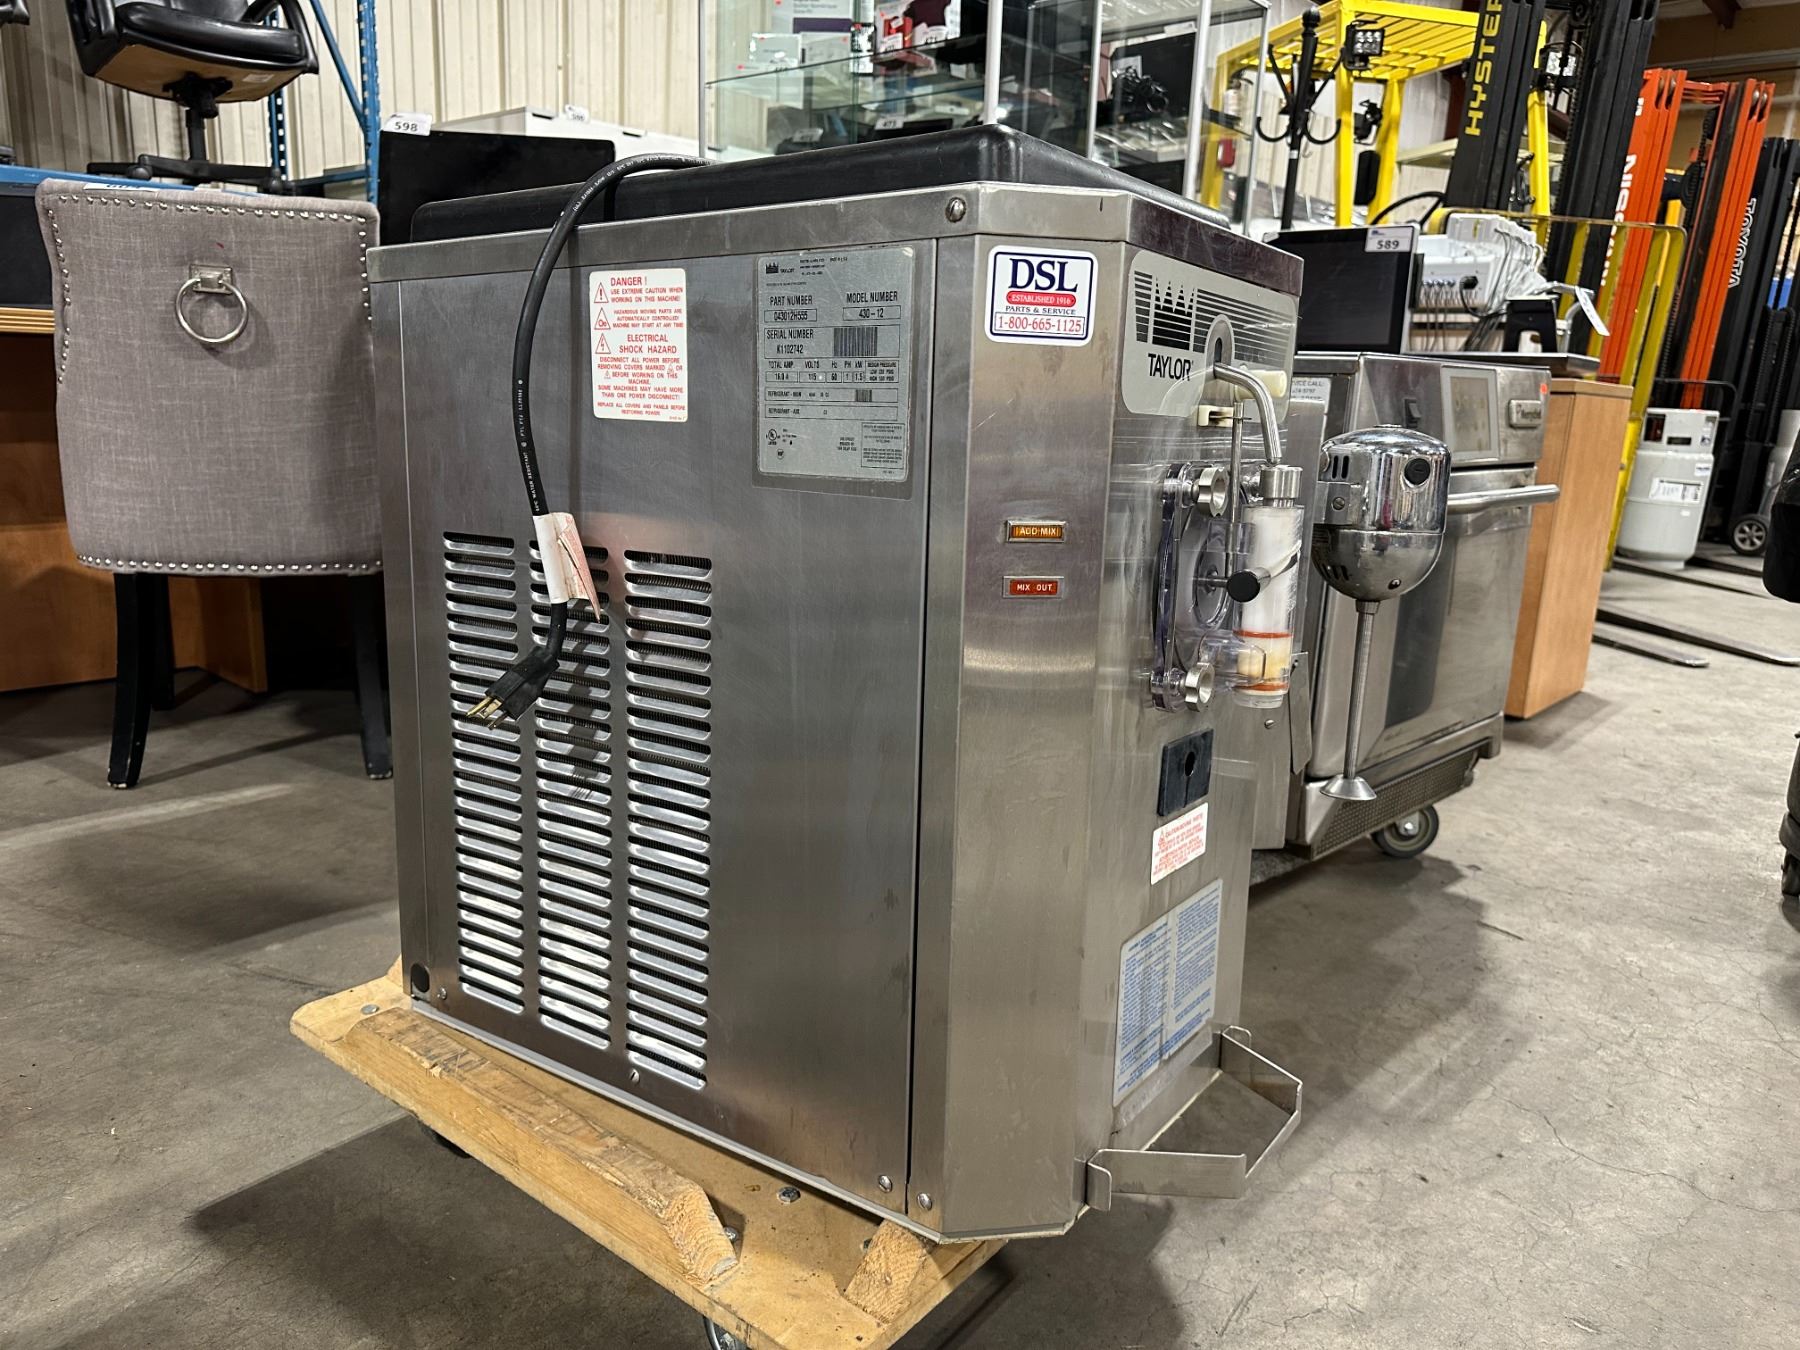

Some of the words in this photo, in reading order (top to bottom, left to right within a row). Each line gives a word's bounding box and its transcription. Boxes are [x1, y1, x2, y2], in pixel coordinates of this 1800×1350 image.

[395, 121, 418, 131] 598
[1600, 154, 1637, 287] NISS
[1376, 240, 1400, 250] 589
[1008, 258, 1078, 292] DSL
[611, 276, 642, 286] DANGER
[770, 296, 785, 306] PART
[787, 295, 813, 305] NUMBER
[847, 292, 868, 303] MODEL
[870, 291, 898, 302] NUMBER
[1011, 295, 1055, 304] ESTABLISHED
[1005, 305, 1031, 313] PARTS
[998, 316, 1083, 333] 1-800-665-1125
[627, 333, 668, 342] ELECTRICAL
[767, 329, 787, 339] SERIAL
[789, 329, 814, 339] NUMBER
[620, 345, 643, 354] SHOCK
[648, 346, 677, 354] HAZARD
[769, 360, 782, 369] TOTAL
[805, 360, 820, 369] VOLTS
[1148, 353, 1192, 381] TAYLOR
[1017, 583, 1030, 591] MIX
[1036, 583, 1053, 591] OUT
